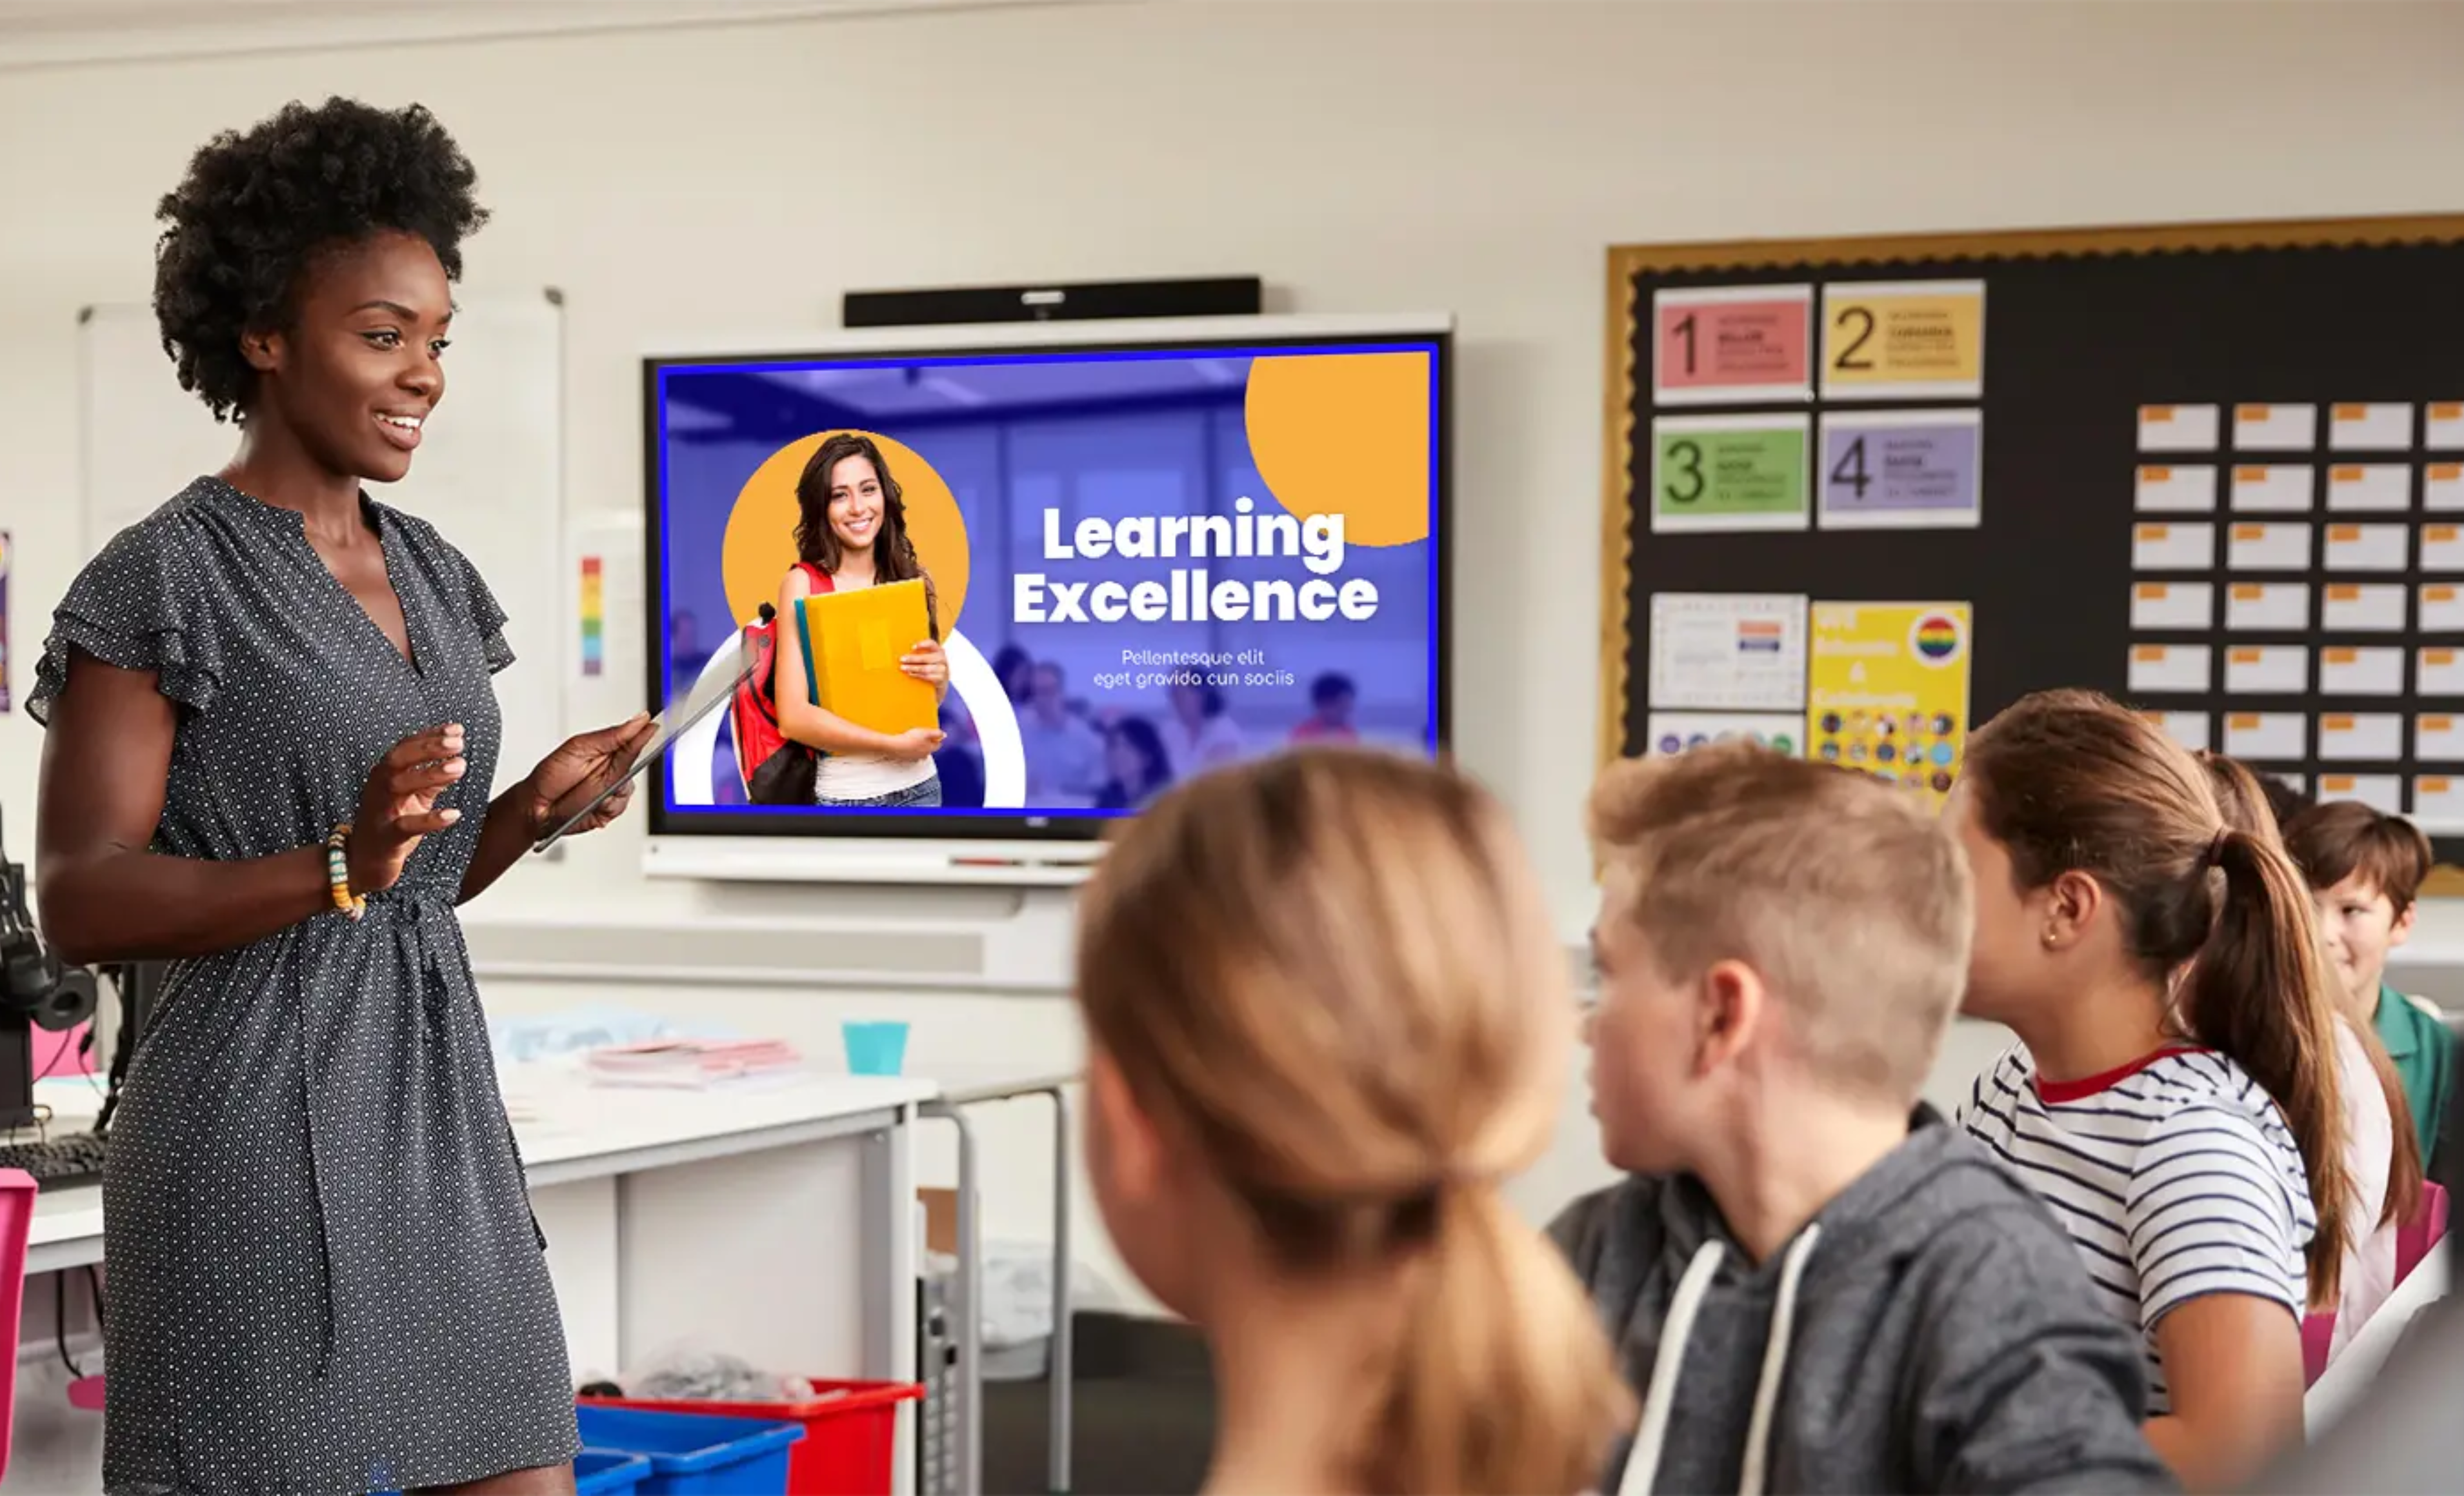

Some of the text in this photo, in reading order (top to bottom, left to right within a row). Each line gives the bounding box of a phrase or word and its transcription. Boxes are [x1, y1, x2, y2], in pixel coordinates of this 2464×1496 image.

[1672, 313, 1696, 376] 1
[1834, 306, 1876, 371] 2
[1665, 439, 1705, 504] 3
[1830, 434, 1872, 501] 4
[1044, 496, 1345, 575] Learning
[1014, 568, 1379, 623] Excellence
[1093, 670, 1295, 690] eget gravida cun sociis
[1121, 648, 1265, 667] Pellentesque elit
